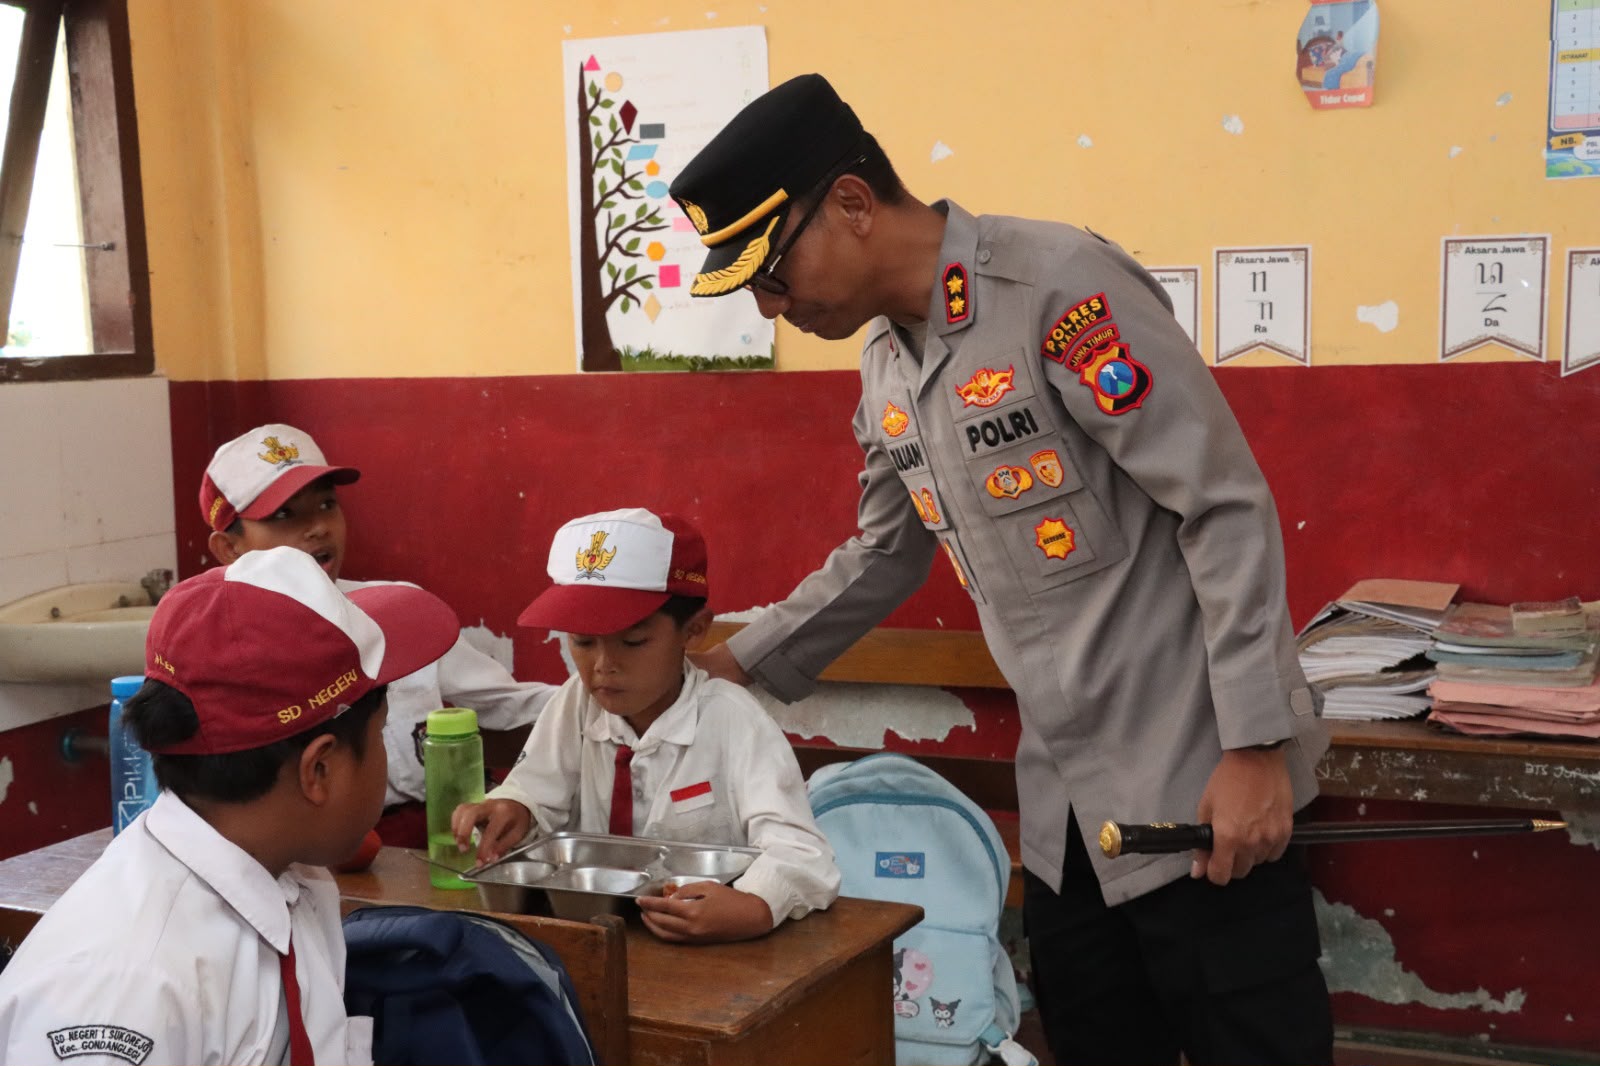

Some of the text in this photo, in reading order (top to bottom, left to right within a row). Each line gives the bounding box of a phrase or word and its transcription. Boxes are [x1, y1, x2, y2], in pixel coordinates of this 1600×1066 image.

[1560, 136, 1577, 145] NB.
[1464, 245, 1526, 254] Aksara Jawa
[1234, 256, 1290, 264] Aksara Jawa
[1159, 275, 1180, 283] Jawa
[1045, 298, 1102, 353] POLRES
[1058, 312, 1097, 351] MALANG
[1254, 324, 1268, 333] Ra
[1484, 317, 1499, 327] Da
[1071, 328, 1114, 367] JAWA TIMUR
[965, 407, 1039, 453] POLRI
[277, 668, 359, 724] SD NEGERI
[54, 1028, 150, 1053] SD NEGERI 1 SUKOREJO
[81, 1040, 142, 1060] GONDANGLEGI
